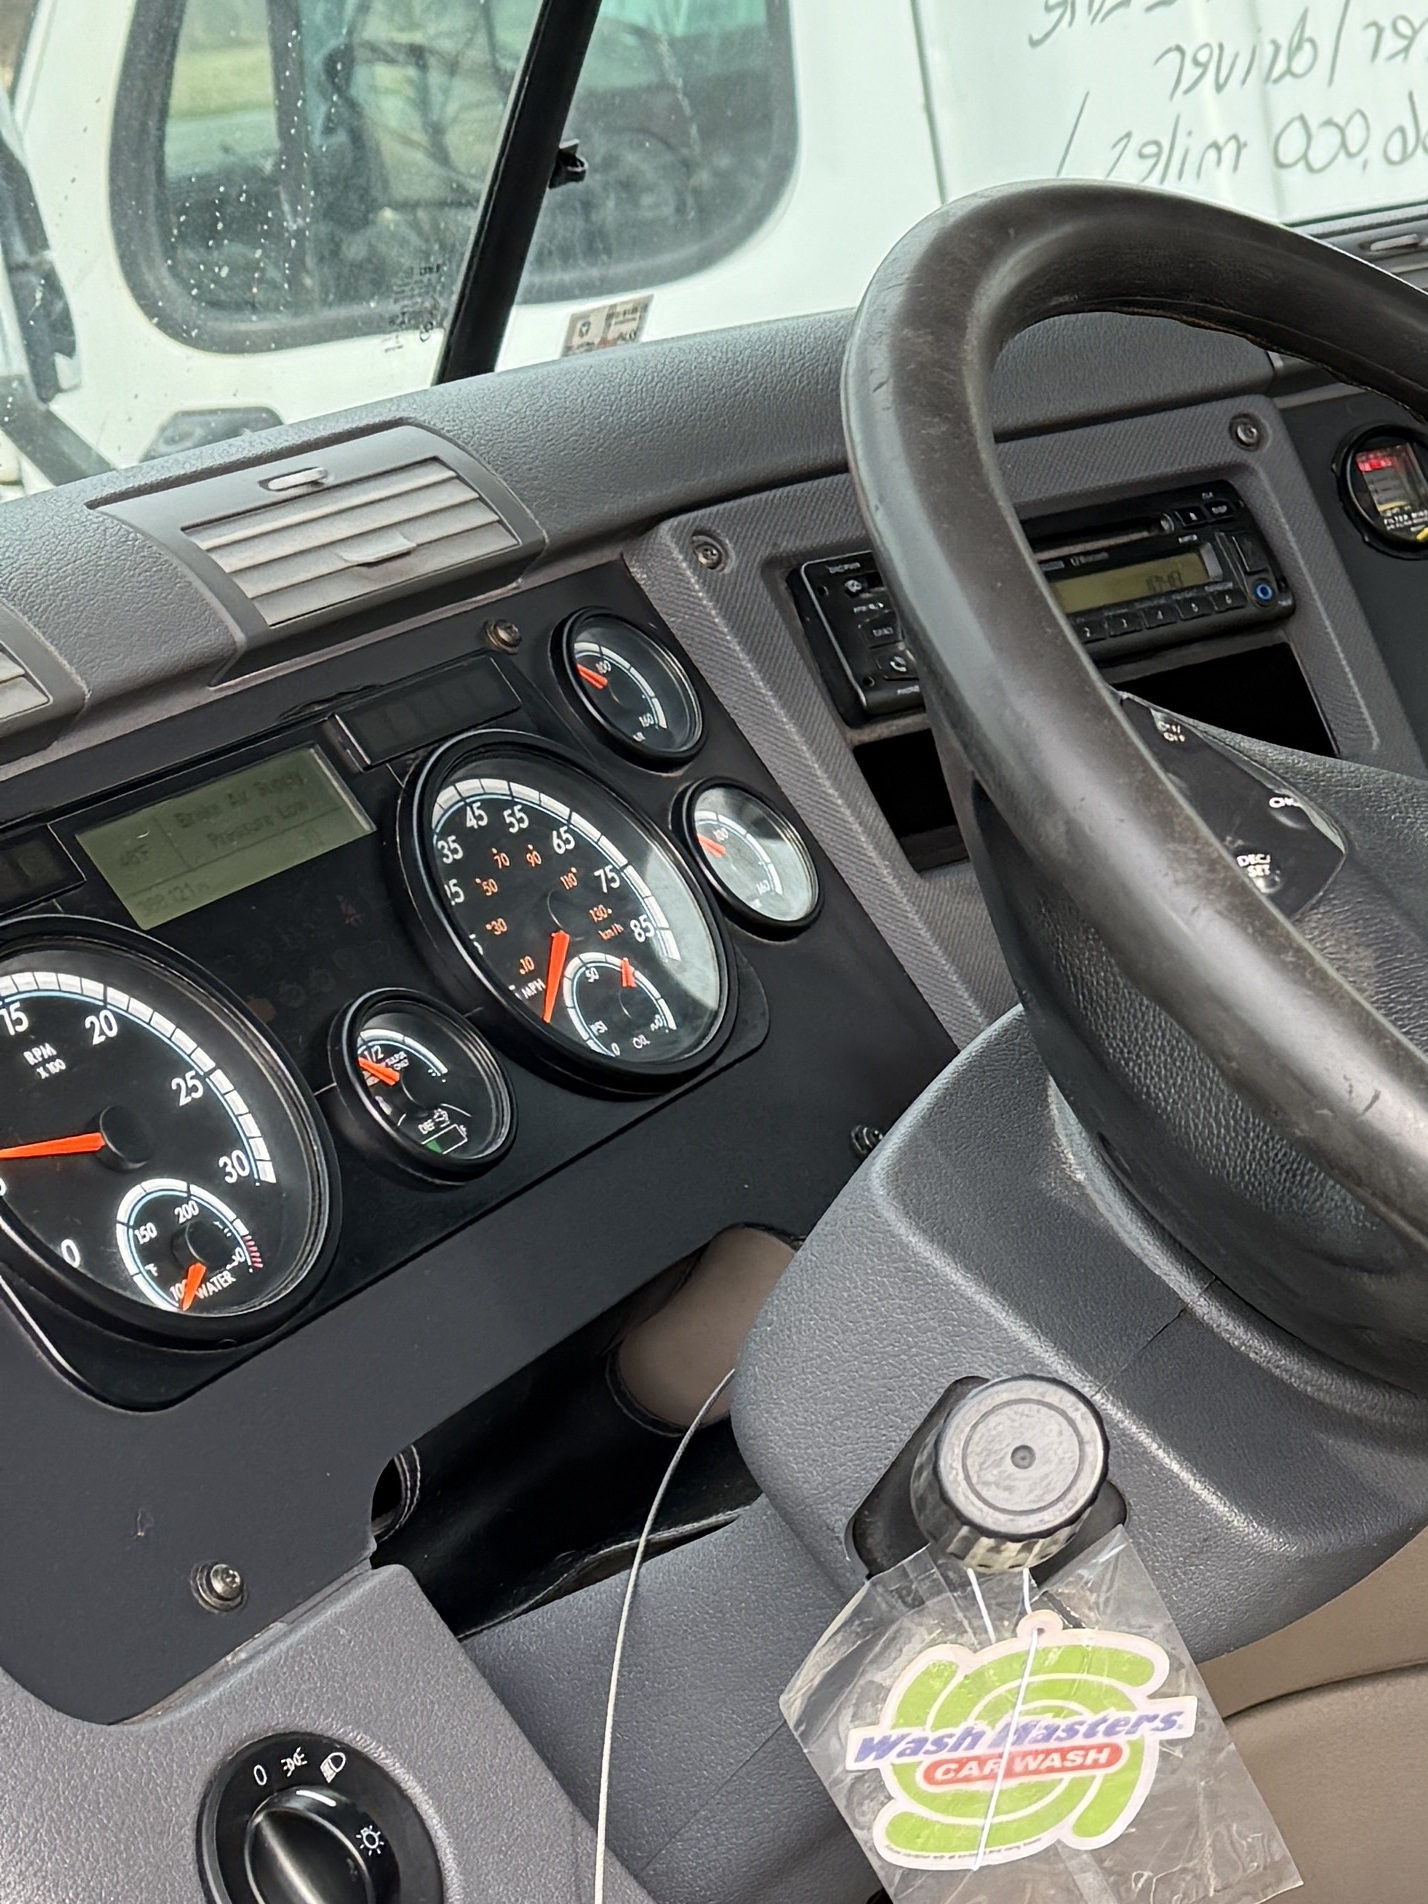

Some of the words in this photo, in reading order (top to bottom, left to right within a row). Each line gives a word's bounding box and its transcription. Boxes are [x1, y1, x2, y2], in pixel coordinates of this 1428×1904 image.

[465, 802, 489, 829] 45
[503, 805, 529, 834] 55
[437, 836, 464, 864] 35
[552, 826, 576, 855] 65
[493, 854, 511, 869] 70
[526, 850, 542, 867] 90
[482, 879, 499, 896] 50
[560, 872, 578, 890] 110
[594, 867, 621, 894] 75
[492, 917, 508, 936] 30
[589, 905, 607, 922] 130
[630, 914, 656, 944] 85
[522, 978, 546, 1000] MPH
[585, 968, 600, 983] 50
[84, 1009, 118, 1045] 20
[24, 1043, 57, 1067] RPM
[611, 1042, 620, 1057] 0
[172, 1070, 204, 1107] 25
[219, 1150, 251, 1184] 30
[174, 1200, 199, 1225] 200
[134, 1222, 158, 1245] 150
[61, 1238, 81, 1268] 0
[195, 1270, 236, 1299] WATER
[854, 1723, 986, 1764] Wash
[989, 1708, 1182, 1751] Masters
[934, 1755, 1001, 1782] CAR
[1011, 1747, 1109, 1774] WASH
